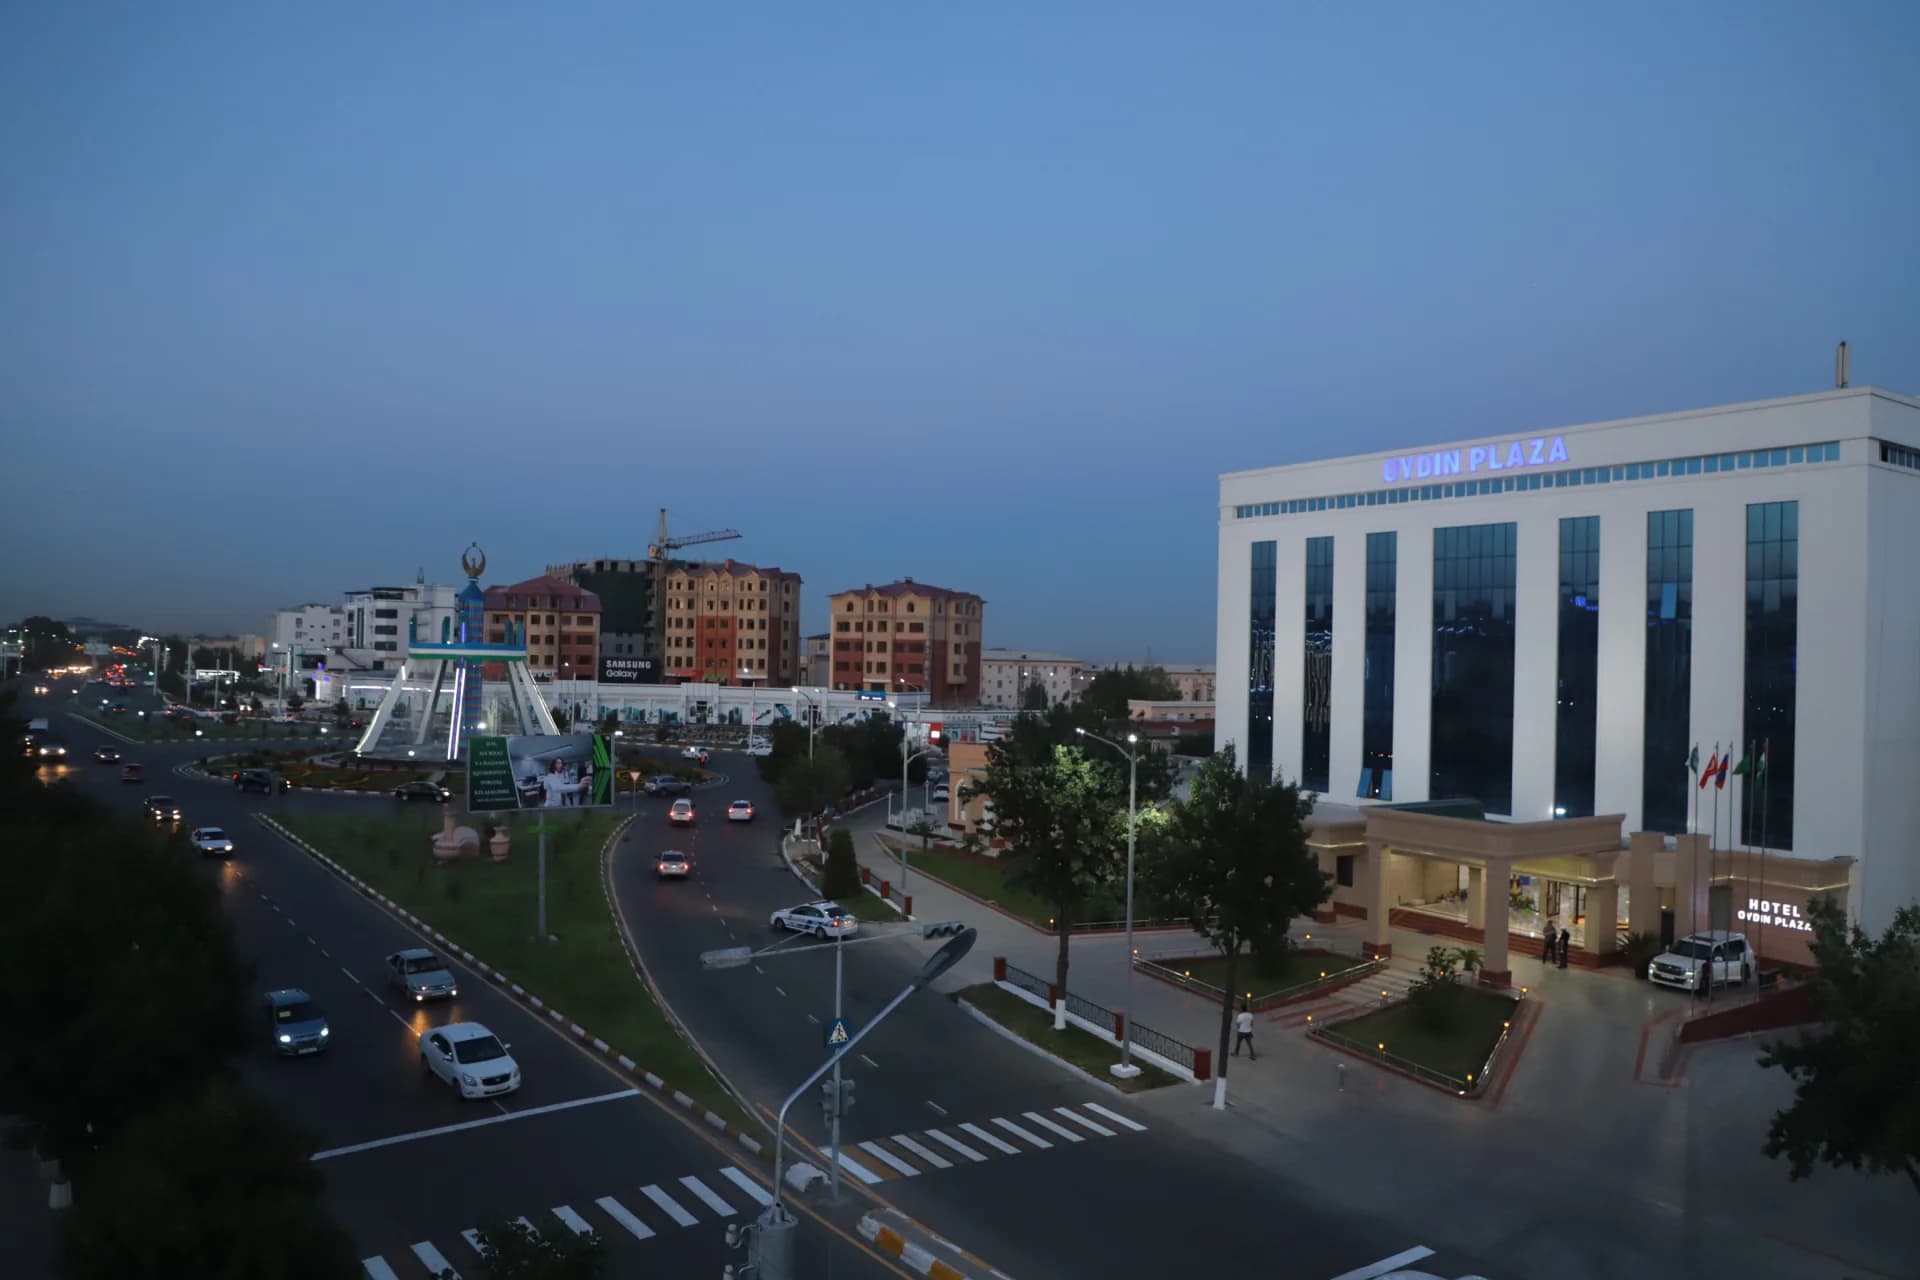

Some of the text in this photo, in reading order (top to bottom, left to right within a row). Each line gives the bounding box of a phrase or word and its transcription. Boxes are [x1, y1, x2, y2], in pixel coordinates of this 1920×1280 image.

[1382, 436, 1569, 483] OYDIN PLAZA
[606, 660, 651, 669] SAMSUNG
[606, 669, 638, 680] Galaxy
[1748, 898, 1801, 918] HOTEL
[1737, 910, 1812, 932] OYDIN PLAZA
